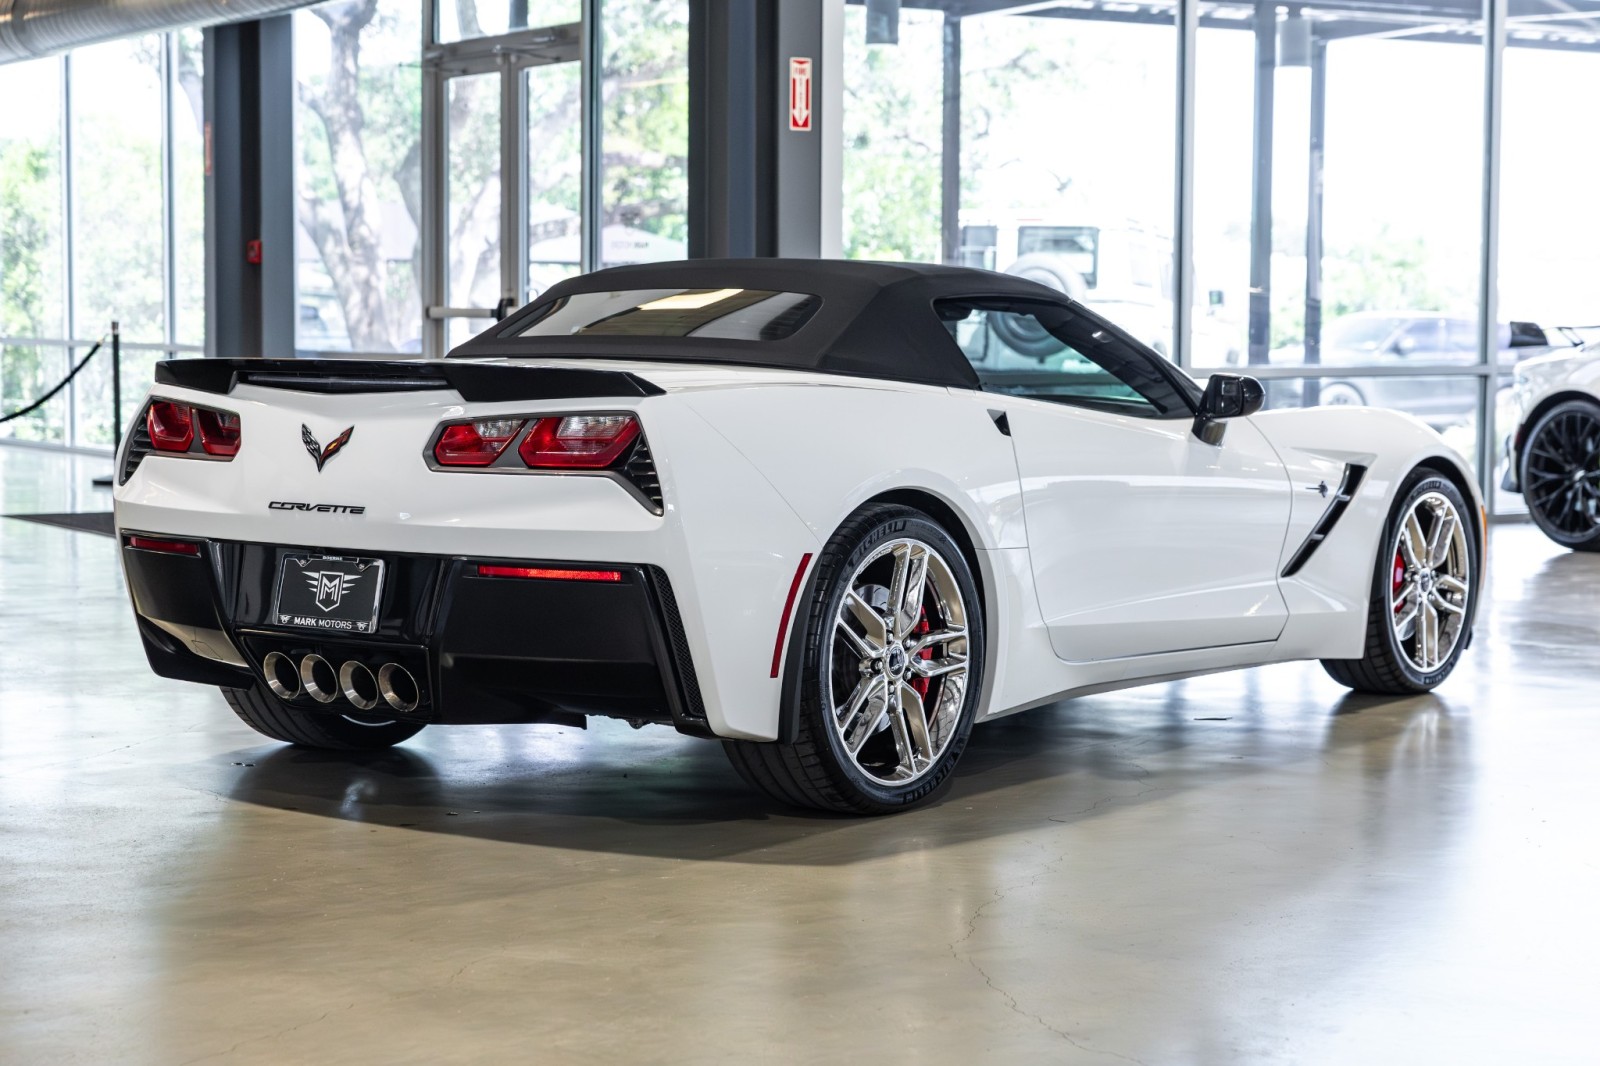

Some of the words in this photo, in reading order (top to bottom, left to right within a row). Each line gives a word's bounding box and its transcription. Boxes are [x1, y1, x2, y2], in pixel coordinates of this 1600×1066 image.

[268, 501, 366, 514] CORVETTE
[293, 616, 317, 626] MARK
[318, 619, 352, 630] MOTORS
